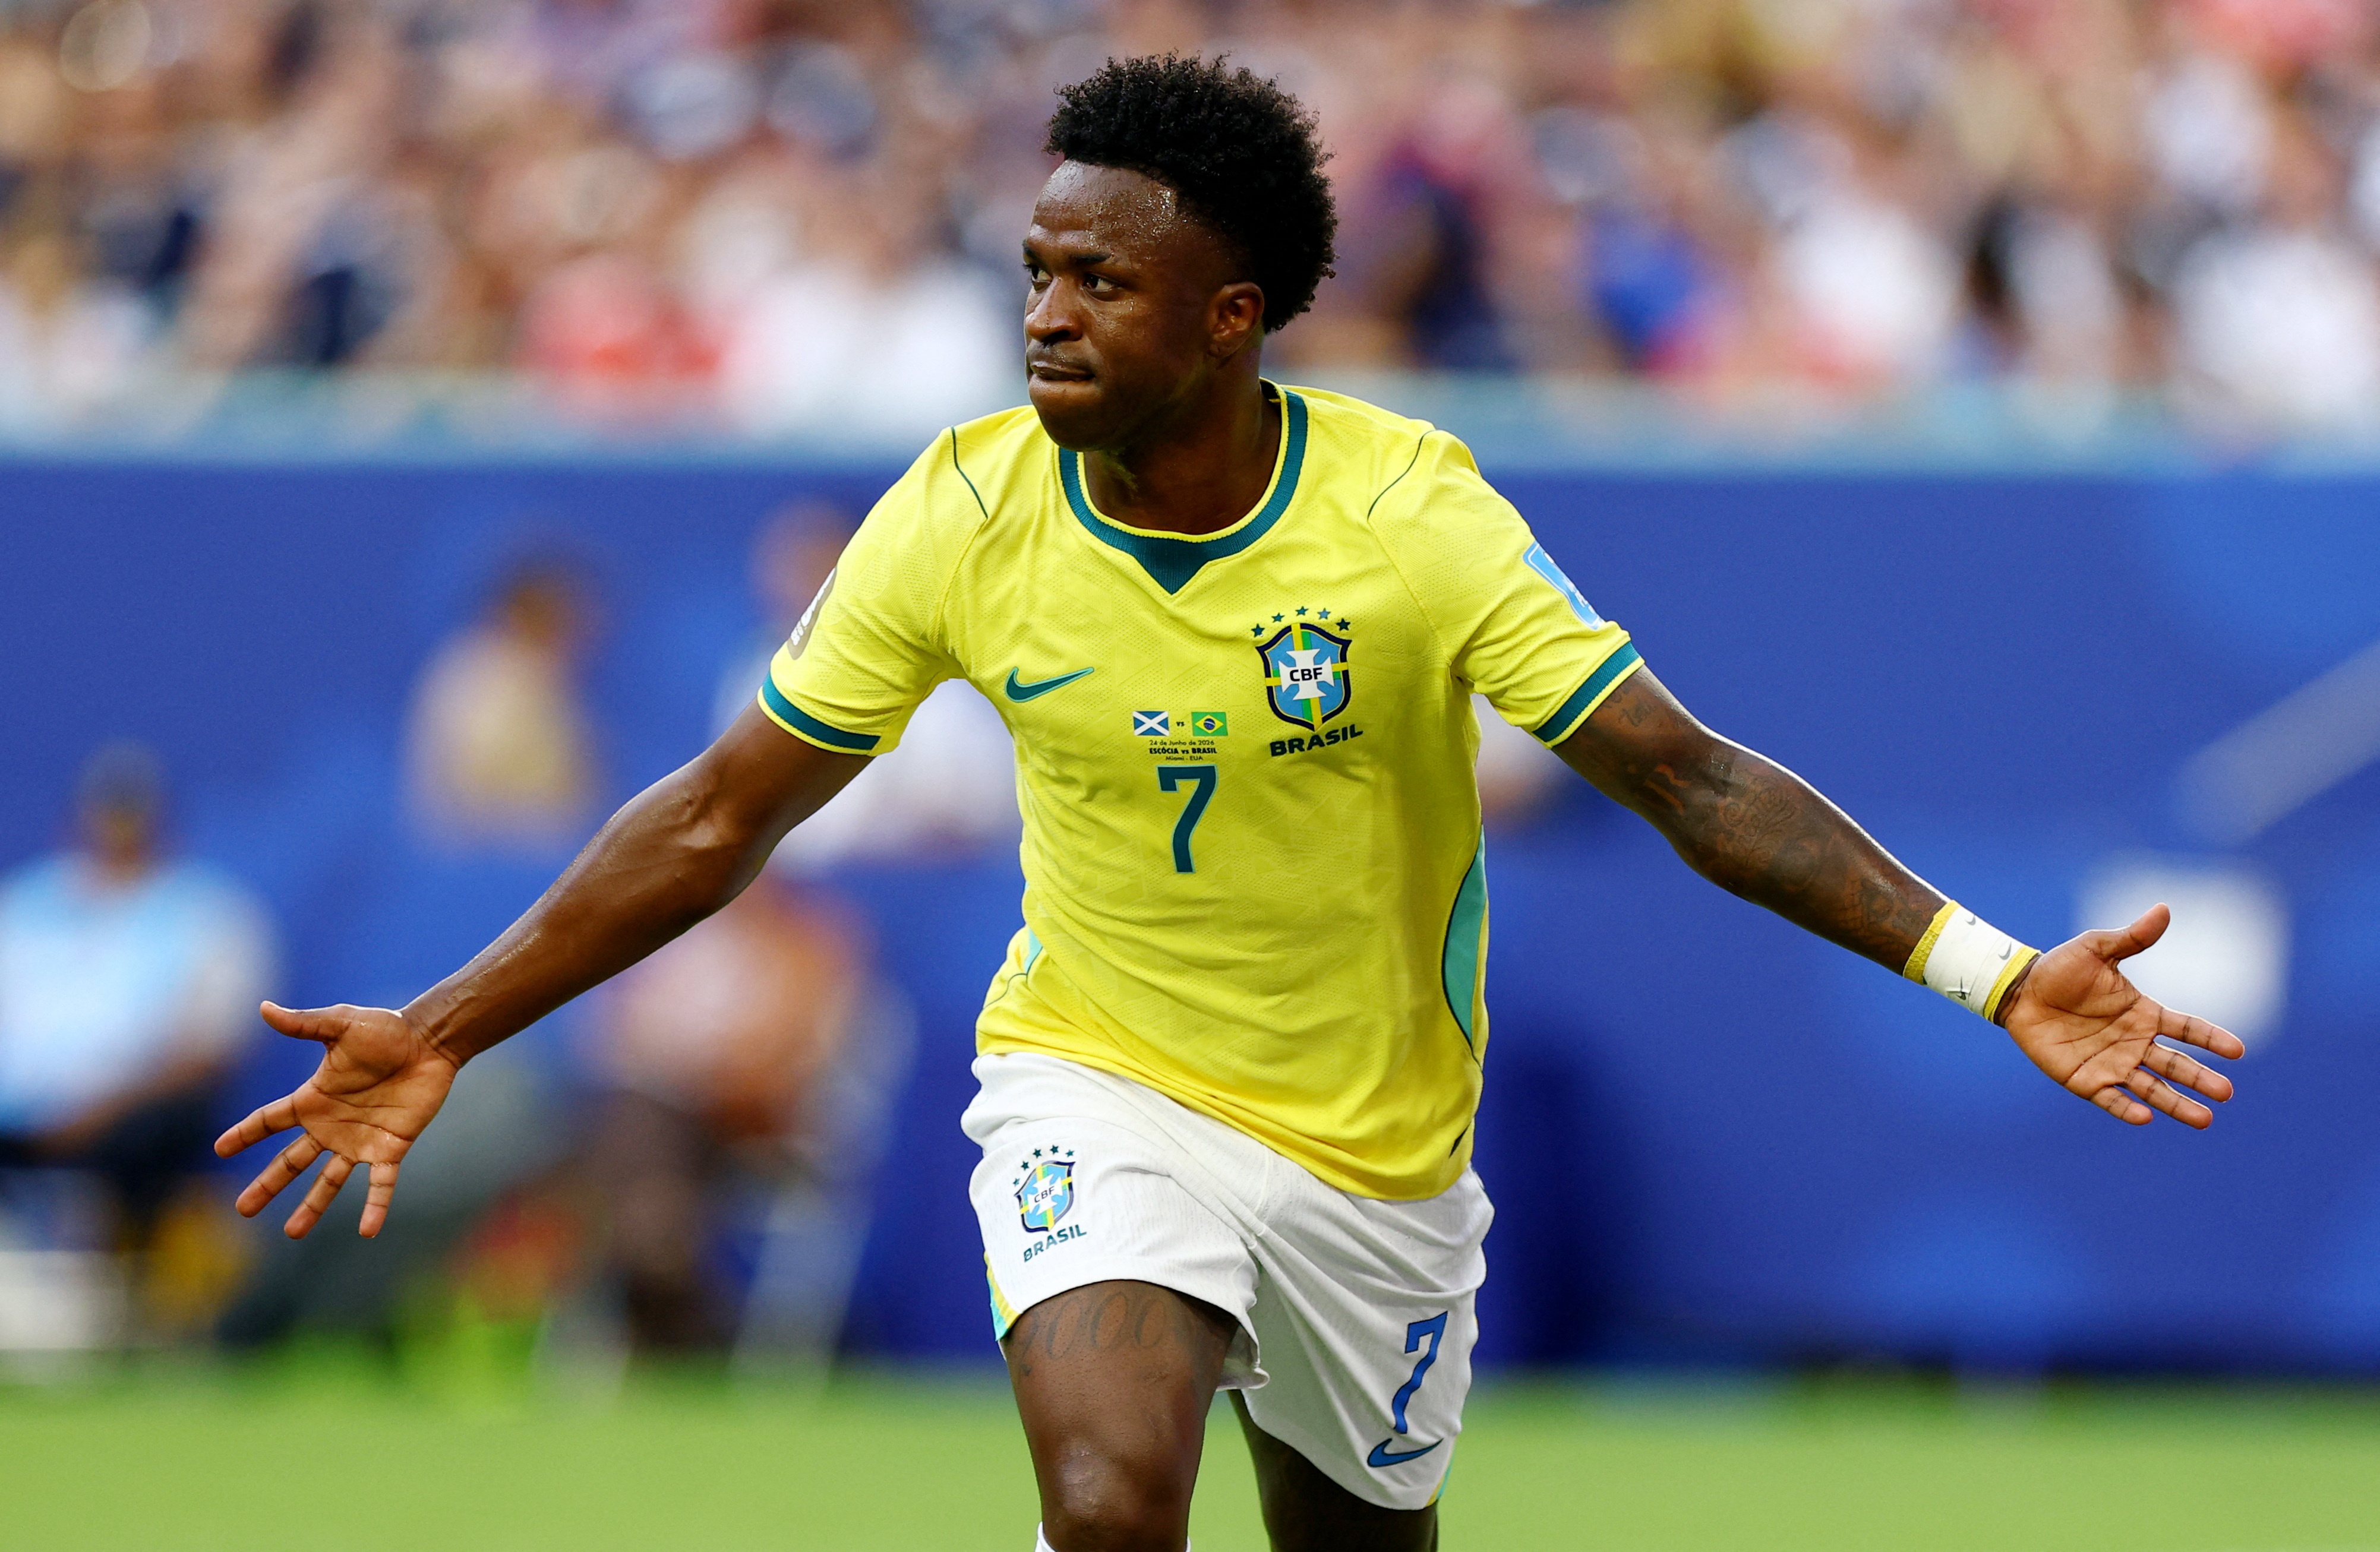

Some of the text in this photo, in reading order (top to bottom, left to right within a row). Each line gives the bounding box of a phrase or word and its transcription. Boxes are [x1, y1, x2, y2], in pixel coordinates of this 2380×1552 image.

[1289, 667, 1322, 682] CBF
[1269, 723, 1363, 757] BRASIL
[1156, 764, 1219, 874] 7
[1034, 1186, 1055, 1204] CBF
[1023, 1224, 1087, 1263] BRASIL
[1391, 1310, 1448, 1435] 7
